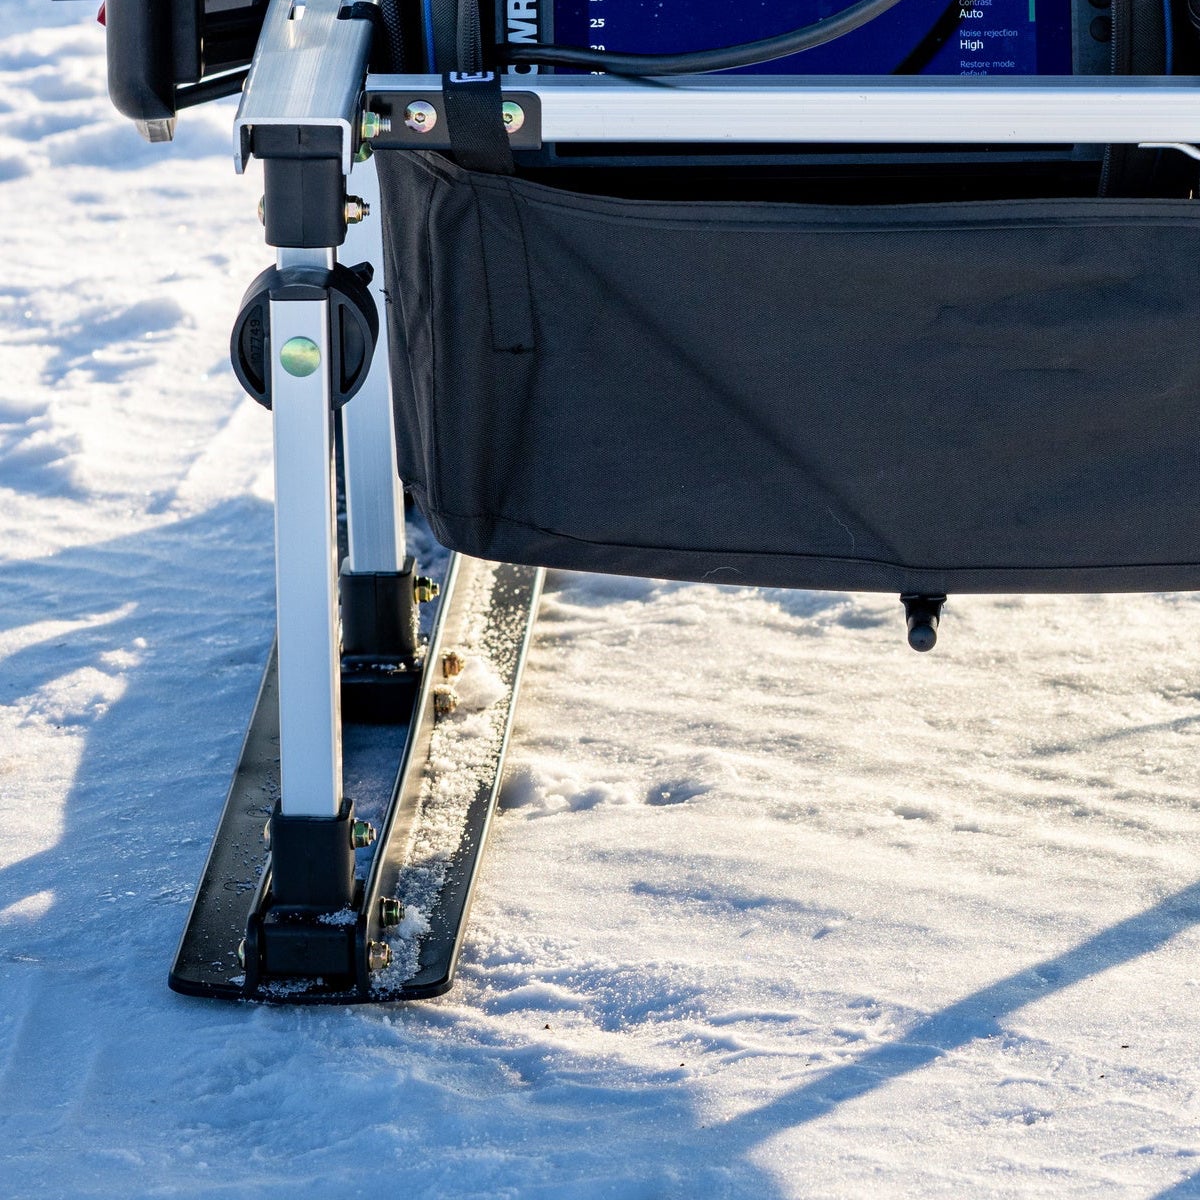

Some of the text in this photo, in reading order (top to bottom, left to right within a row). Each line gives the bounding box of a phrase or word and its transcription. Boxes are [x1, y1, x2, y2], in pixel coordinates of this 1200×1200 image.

[959, 8, 984, 19] Auto
[589, 18, 605, 28] 25
[960, 28, 1018, 38] Noise rejection
[960, 39, 984, 51] High
[960, 60, 1016, 68] Restore mode
